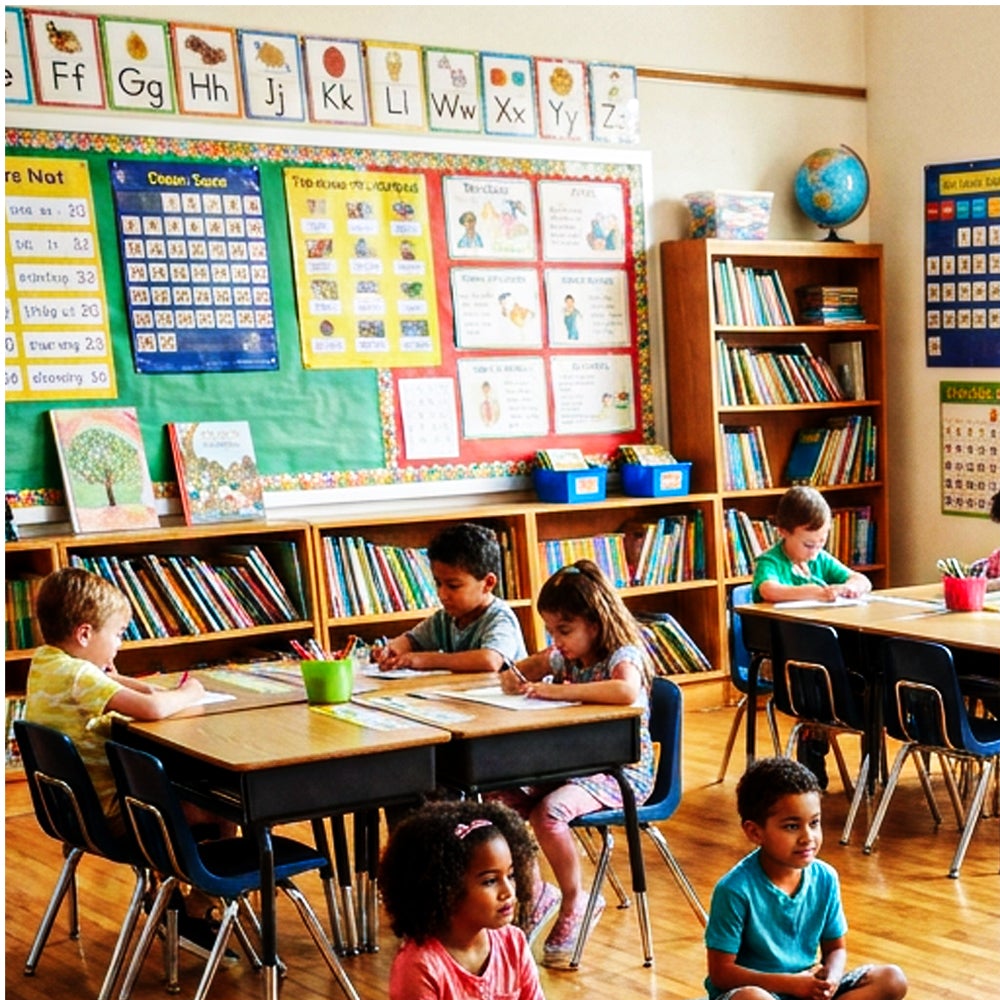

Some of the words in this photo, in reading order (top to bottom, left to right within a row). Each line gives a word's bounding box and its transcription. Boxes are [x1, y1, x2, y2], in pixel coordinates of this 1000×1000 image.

[51, 60, 86, 92] Ff
[117, 66, 164, 109] Gg
[188, 71, 230, 103] Hh
[264, 76, 286, 117] Jj
[321, 80, 355, 112] Kk
[385, 85, 409, 116] Ll
[429, 92, 477, 120] Ww
[493, 94, 526, 124] Xx
[548, 98, 579, 137] Yy
[27, 167, 65, 185] Not
